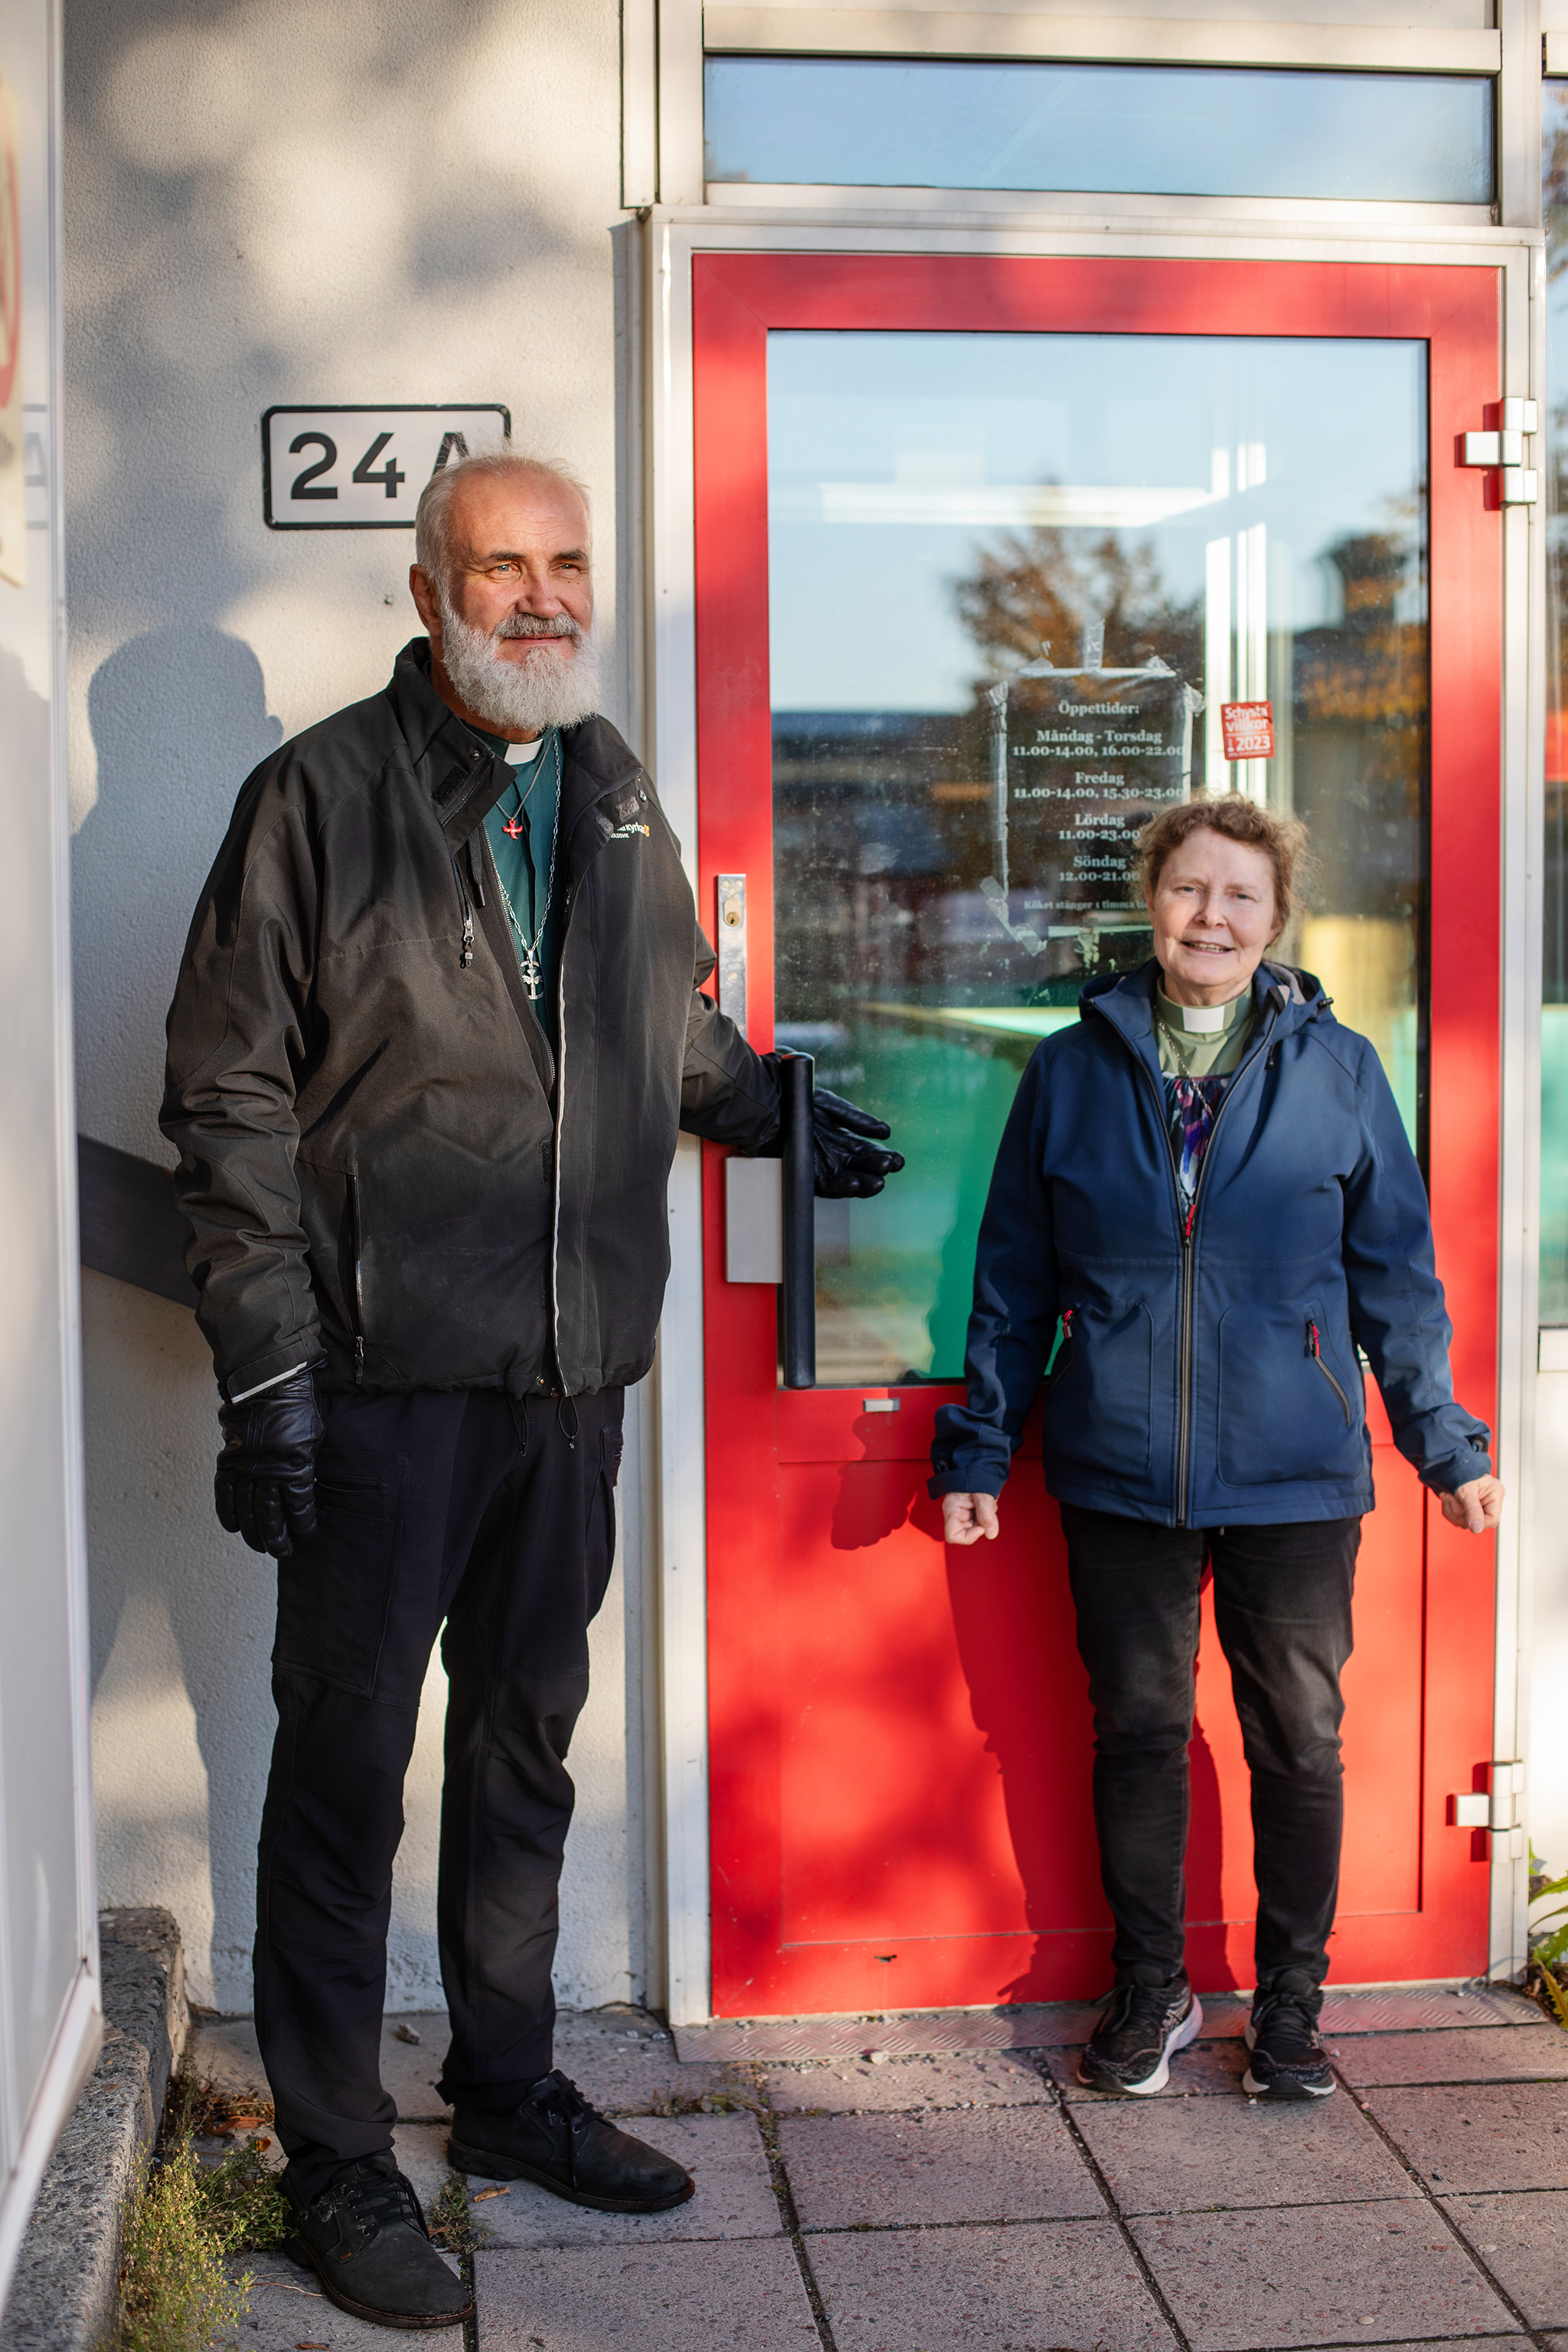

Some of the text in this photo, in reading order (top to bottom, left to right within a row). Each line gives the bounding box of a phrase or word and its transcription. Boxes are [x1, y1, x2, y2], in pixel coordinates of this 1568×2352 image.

[1058, 699, 1140, 717] Öppettider:
[1224, 704, 1269, 720] Schysta
[1225, 718, 1269, 732] villkor
[1037, 729, 1094, 745] Måndag
[1103, 729, 1162, 745] Torsdag
[1235, 735, 1271, 752] 2023
[1012, 743, 1183, 758] 11.00-14.00, 16.00-22.00
[1074, 771, 1125, 787] Fredag
[1014, 787, 1184, 800] 11.00-14.00, 15.30-23.00
[1074, 813, 1125, 828] Lördag
[1058, 829, 1141, 841] 11.00-23.00
[1073, 854, 1126, 870] Söndag
[1024, 900, 1054, 910] Köket
[1055, 900, 1093, 911] stänger
